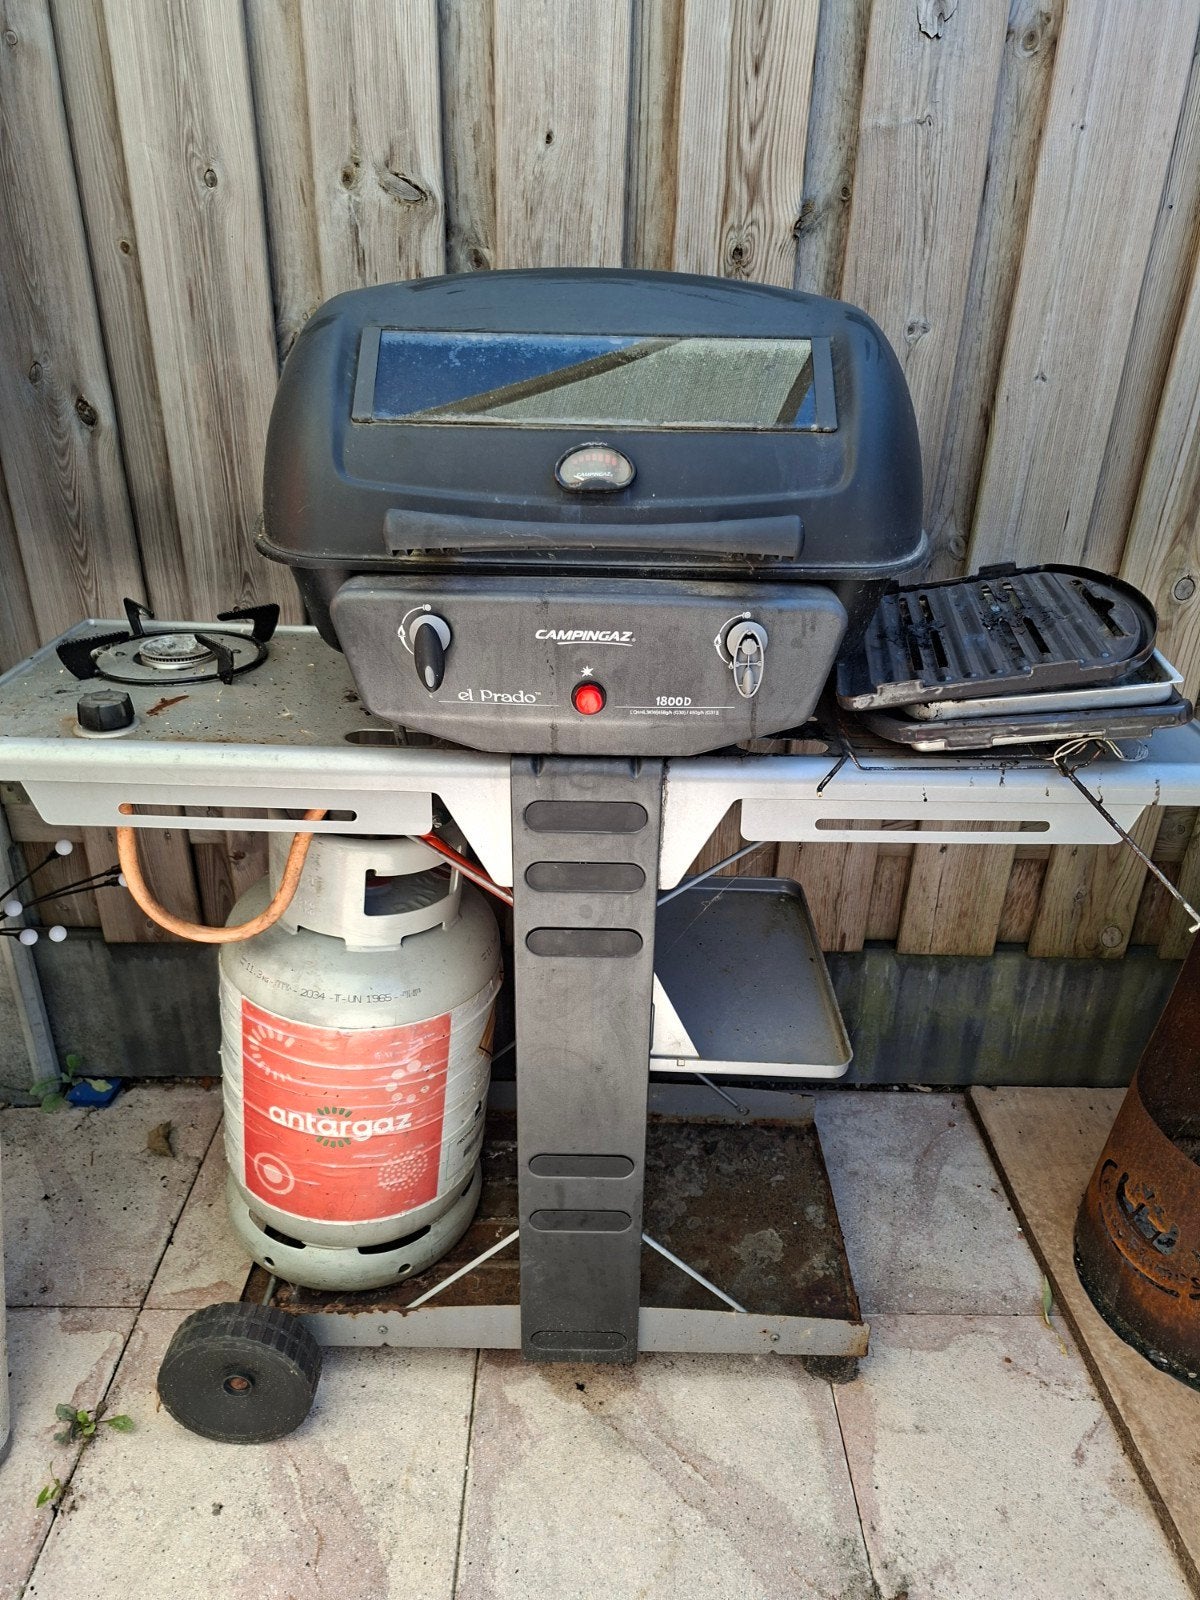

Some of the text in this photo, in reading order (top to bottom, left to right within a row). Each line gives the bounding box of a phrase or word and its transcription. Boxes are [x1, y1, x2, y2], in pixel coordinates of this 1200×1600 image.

[458, 689, 474, 701] el
[656, 696, 692, 706] 1800D
[366, 993, 392, 1003] 1965
[269, 1105, 413, 1141] antargaz
